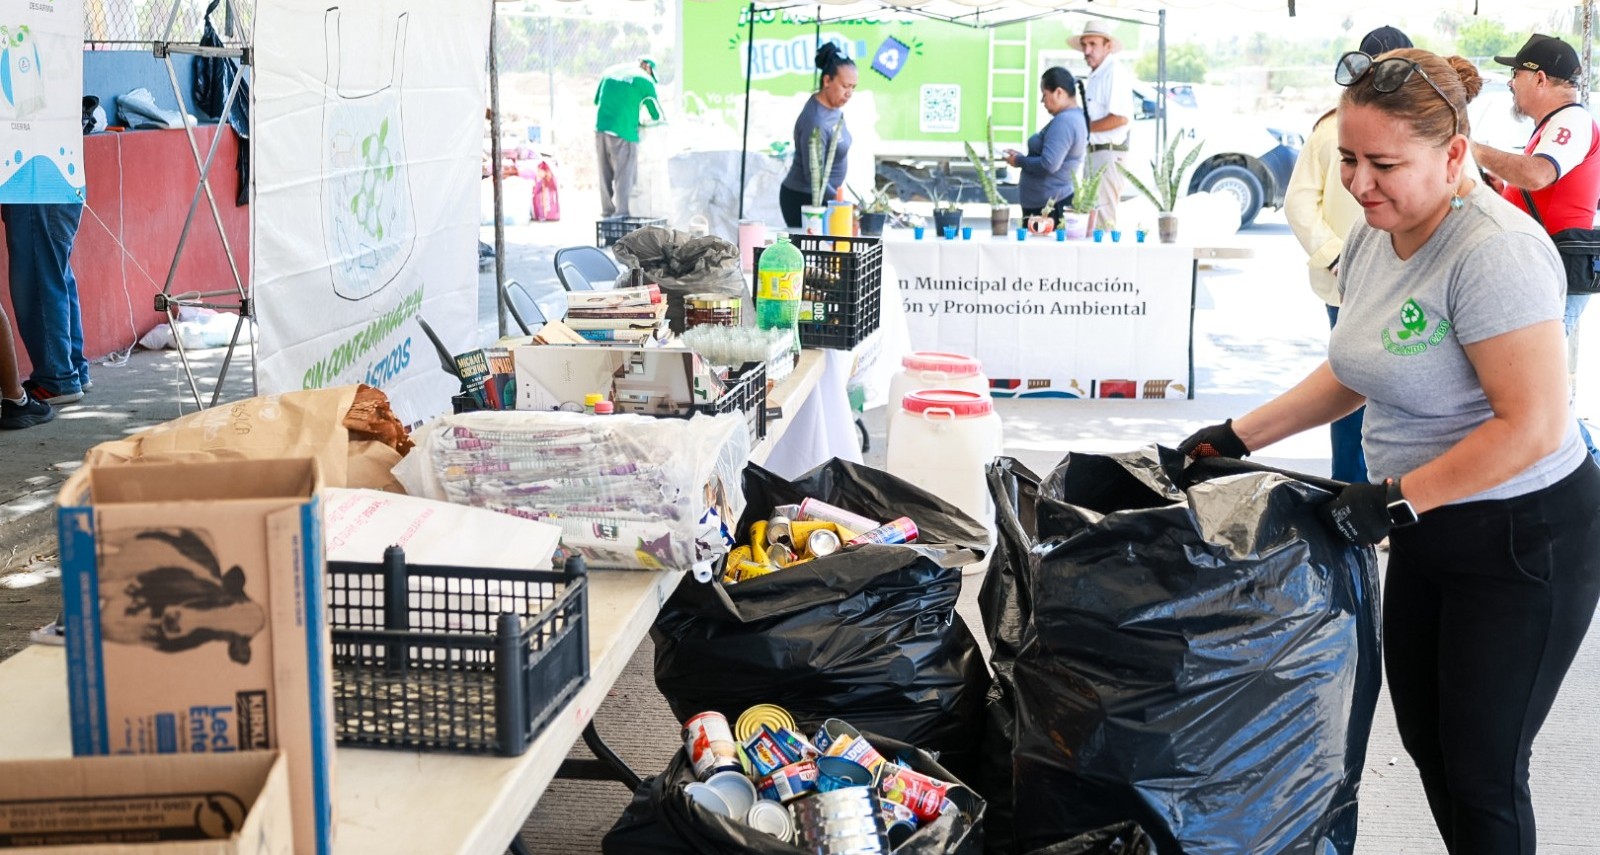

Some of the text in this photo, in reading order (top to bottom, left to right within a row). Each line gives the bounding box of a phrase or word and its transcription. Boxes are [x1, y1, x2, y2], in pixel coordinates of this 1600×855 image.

[1552, 127, 1571, 145] B
[914, 276, 1007, 294] Municipal
[1012, 277, 1033, 292] de
[1039, 277, 1140, 296] Educación,
[813, 302, 825, 321] 300
[927, 301, 939, 316] y
[944, 299, 1045, 315] Promoción
[1050, 301, 1147, 316] Ambiental
[456, 352, 484, 369] MICHAEL
[302, 356, 326, 390] SIN
